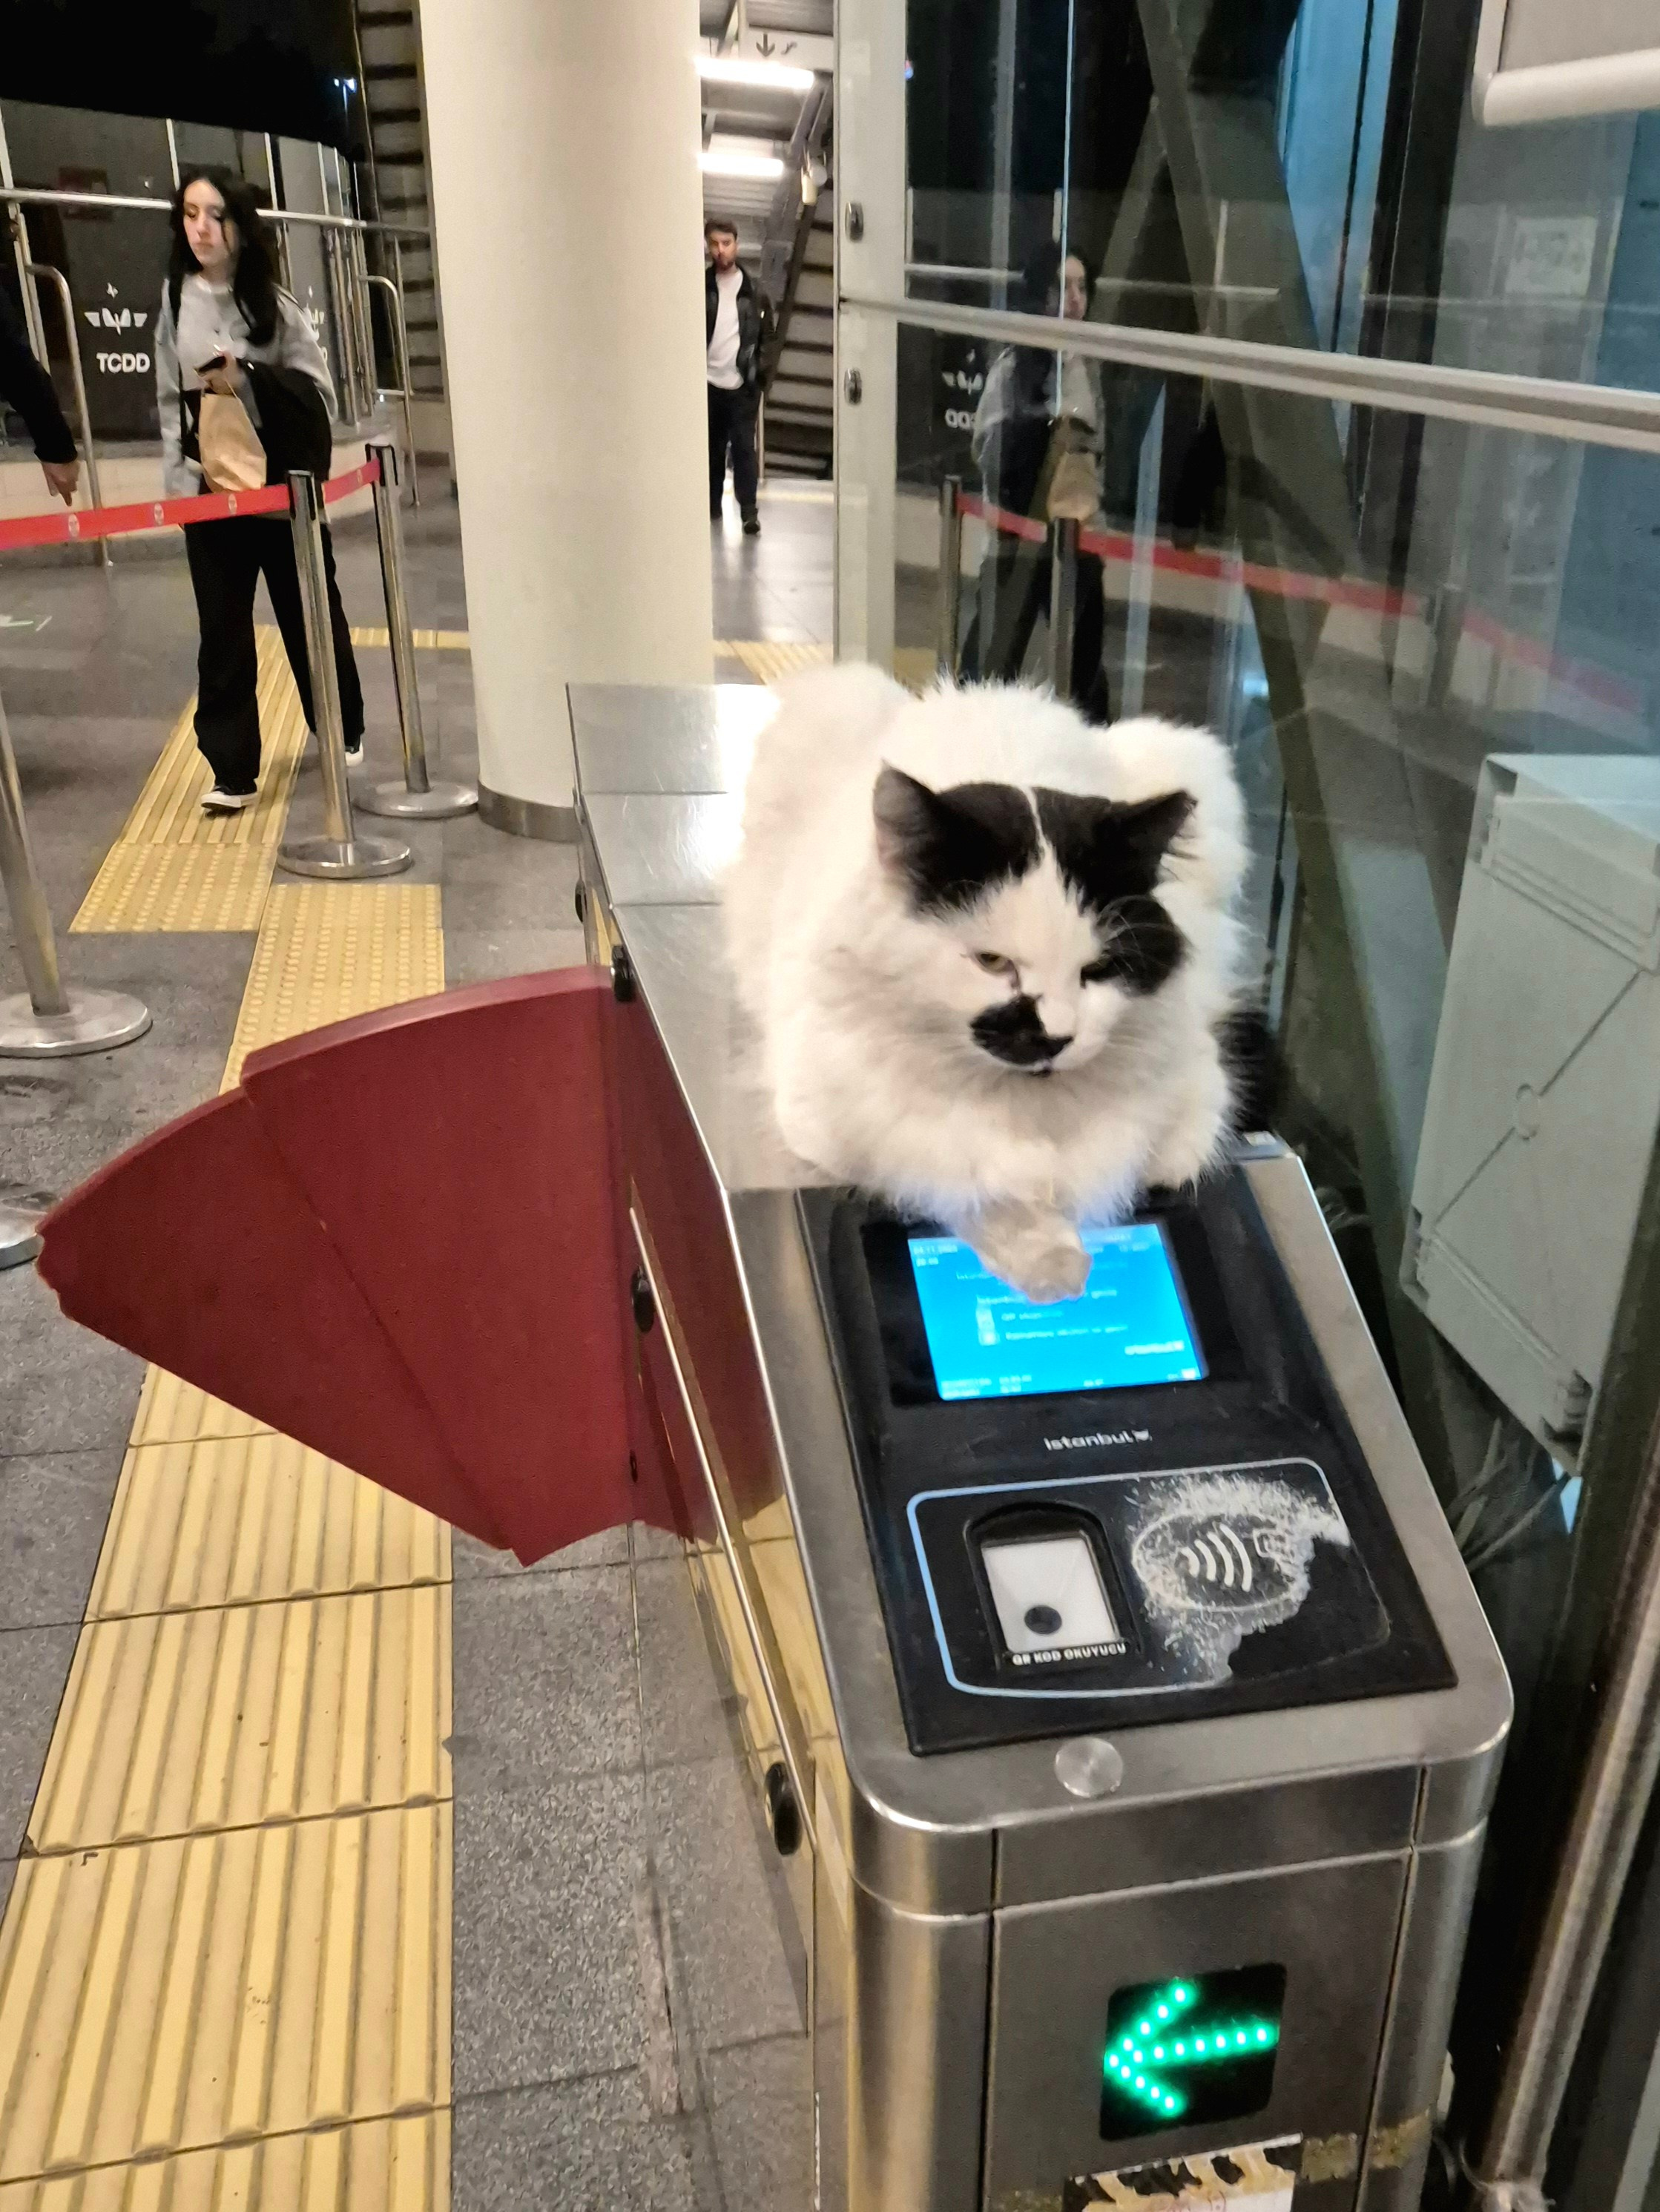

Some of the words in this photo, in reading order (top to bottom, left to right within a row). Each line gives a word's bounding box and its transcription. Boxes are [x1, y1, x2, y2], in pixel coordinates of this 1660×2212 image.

[96, 352, 151, 374] TCDD
[1033, 1650, 1062, 1664] KOD
[1064, 1642, 1127, 1661] OKUYUCU
